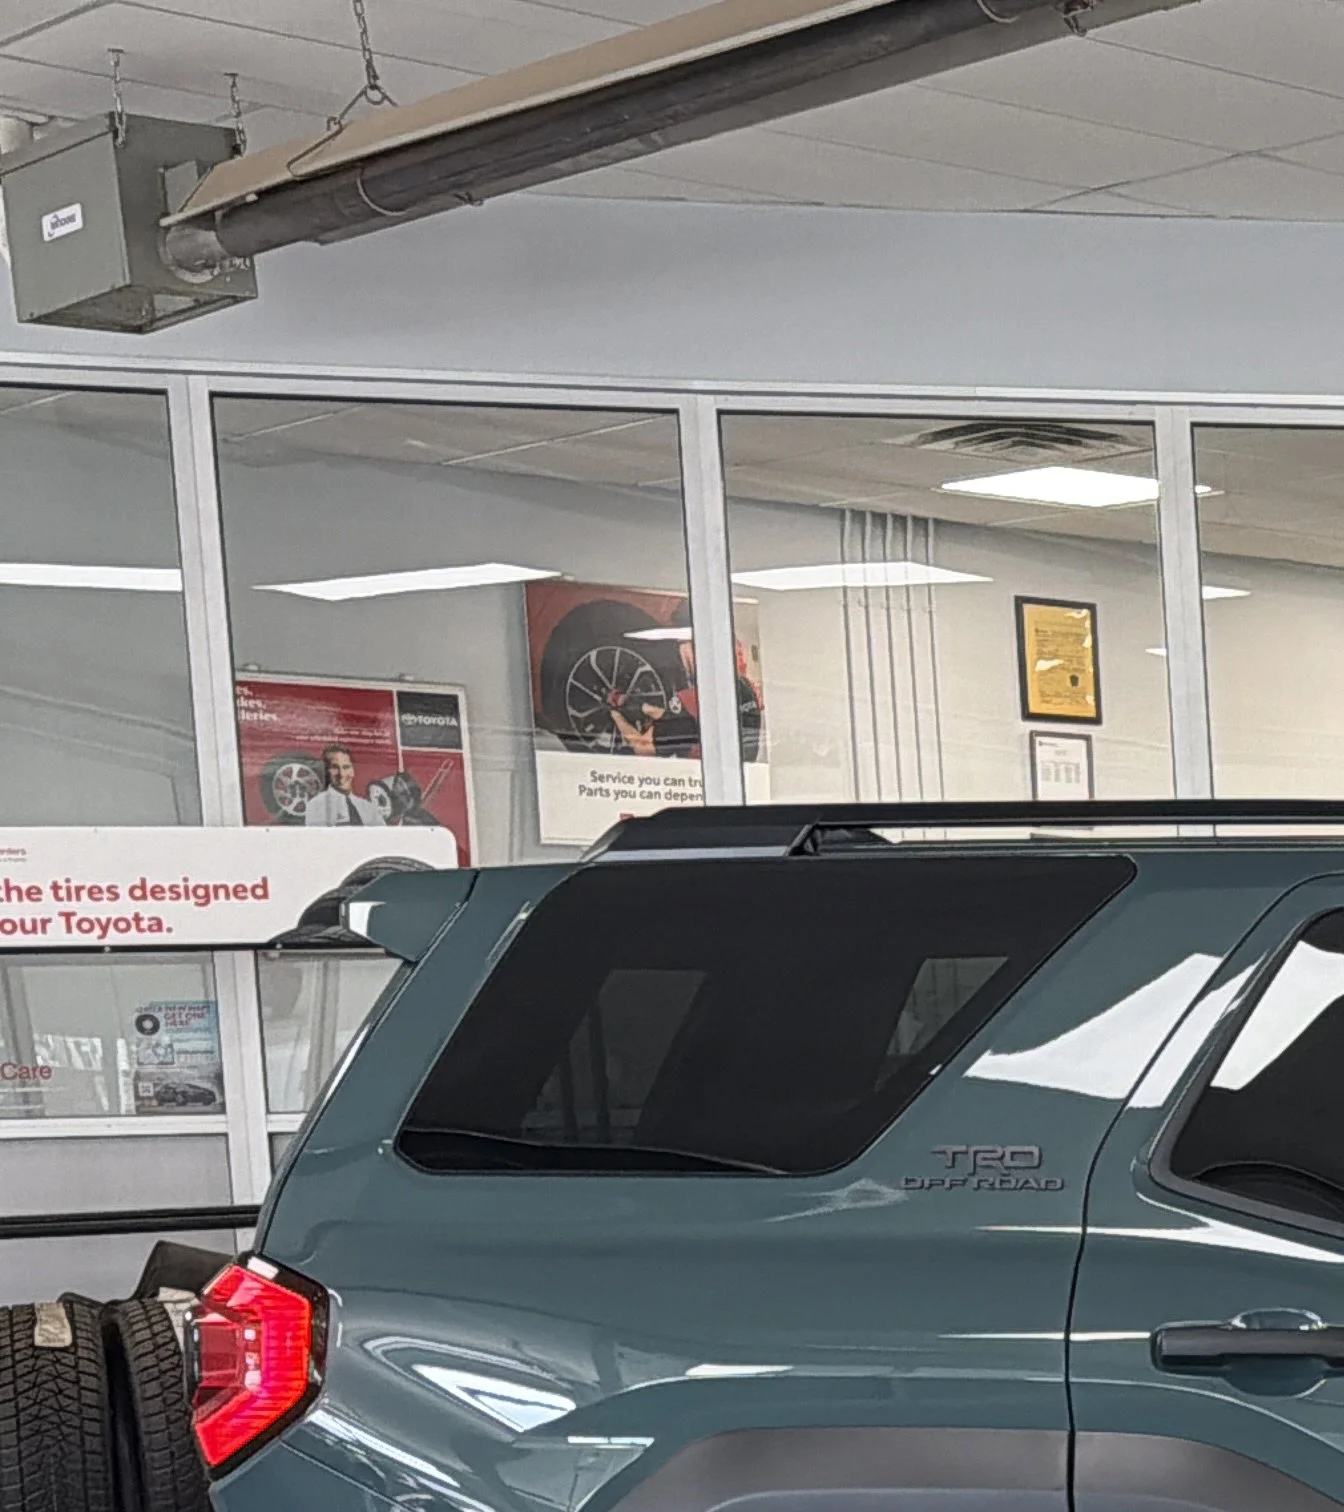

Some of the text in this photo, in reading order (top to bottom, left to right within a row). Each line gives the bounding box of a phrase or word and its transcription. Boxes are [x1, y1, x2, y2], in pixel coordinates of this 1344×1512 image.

[416, 717, 459, 727] TOYOTA
[589, 769, 635, 785] Service
[638, 776, 661, 788] you
[663, 777, 686, 788] can
[578, 784, 612, 798] Parts
[613, 789, 637, 801] you
[639, 789, 662, 800] can
[50, 877, 121, 902] tires
[128, 876, 270, 907] designed
[58, 910, 174, 940] Toyota.
[0, 1063, 53, 1080] Care
[931, 1144, 1043, 1176] TRD
[901, 1176, 1065, 1191] OFF ROAD
